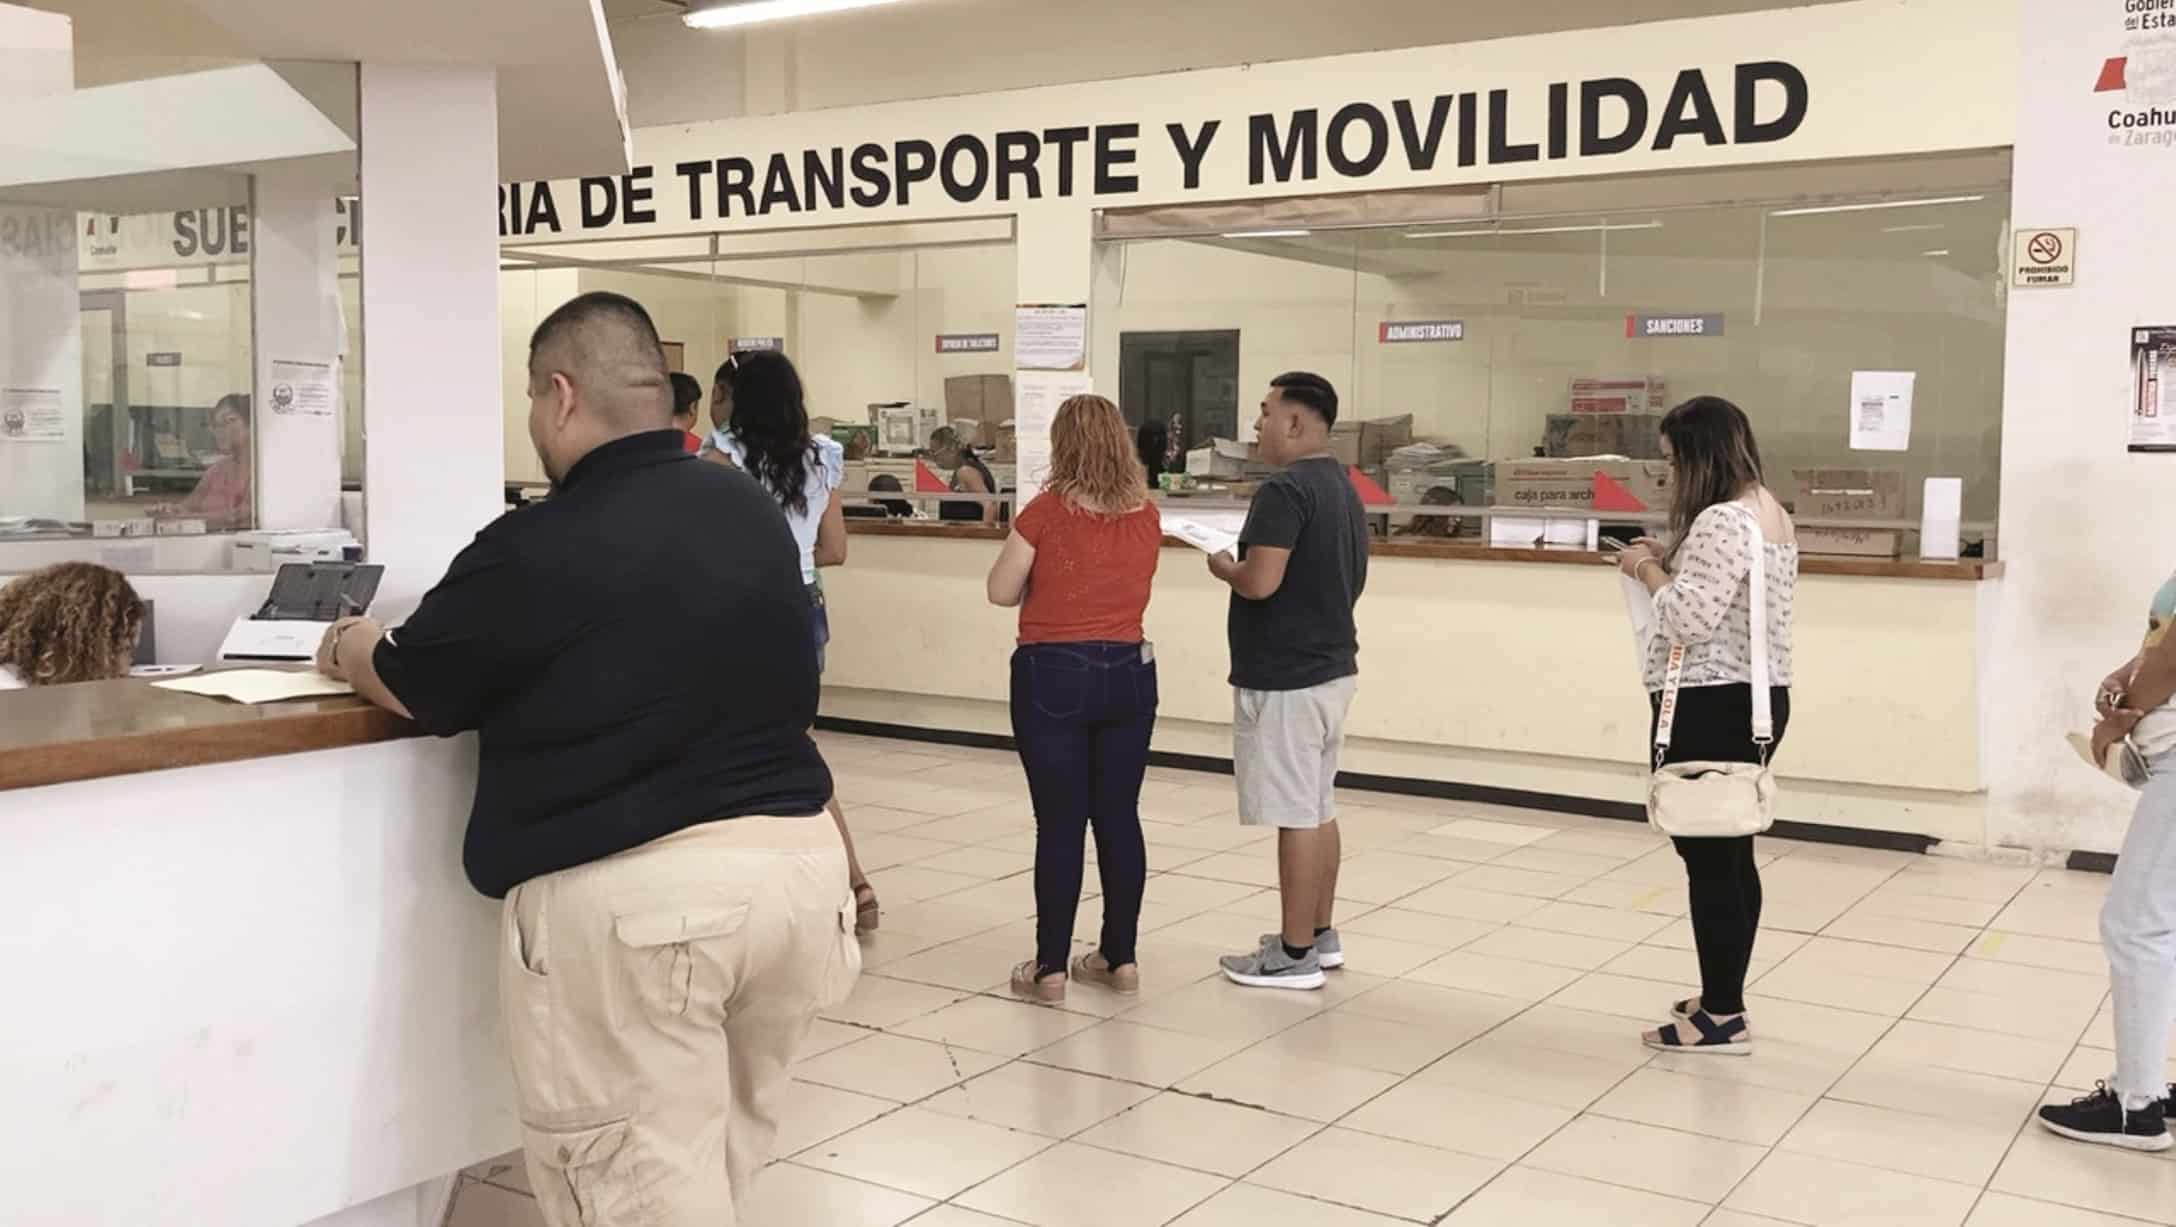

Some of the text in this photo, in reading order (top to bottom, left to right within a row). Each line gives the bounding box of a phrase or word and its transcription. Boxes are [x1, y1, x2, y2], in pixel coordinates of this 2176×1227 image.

[2142, 11, 2176, 30] Esta
[580, 166, 657, 229] DE
[676, 123, 1139, 220] TRANSPORTE
[1166, 120, 1221, 189] Y
[1249, 61, 1809, 186] MOVILIDAD
[2122, 130, 2176, 148] Zarag
[2018, 265, 2069, 274] PROHIBIDO
[2026, 275, 2059, 283] FUMAR
[1646, 318, 1704, 335] SANCIONES
[1514, 489, 1538, 504] caja
[1540, 490, 1567, 502] para
